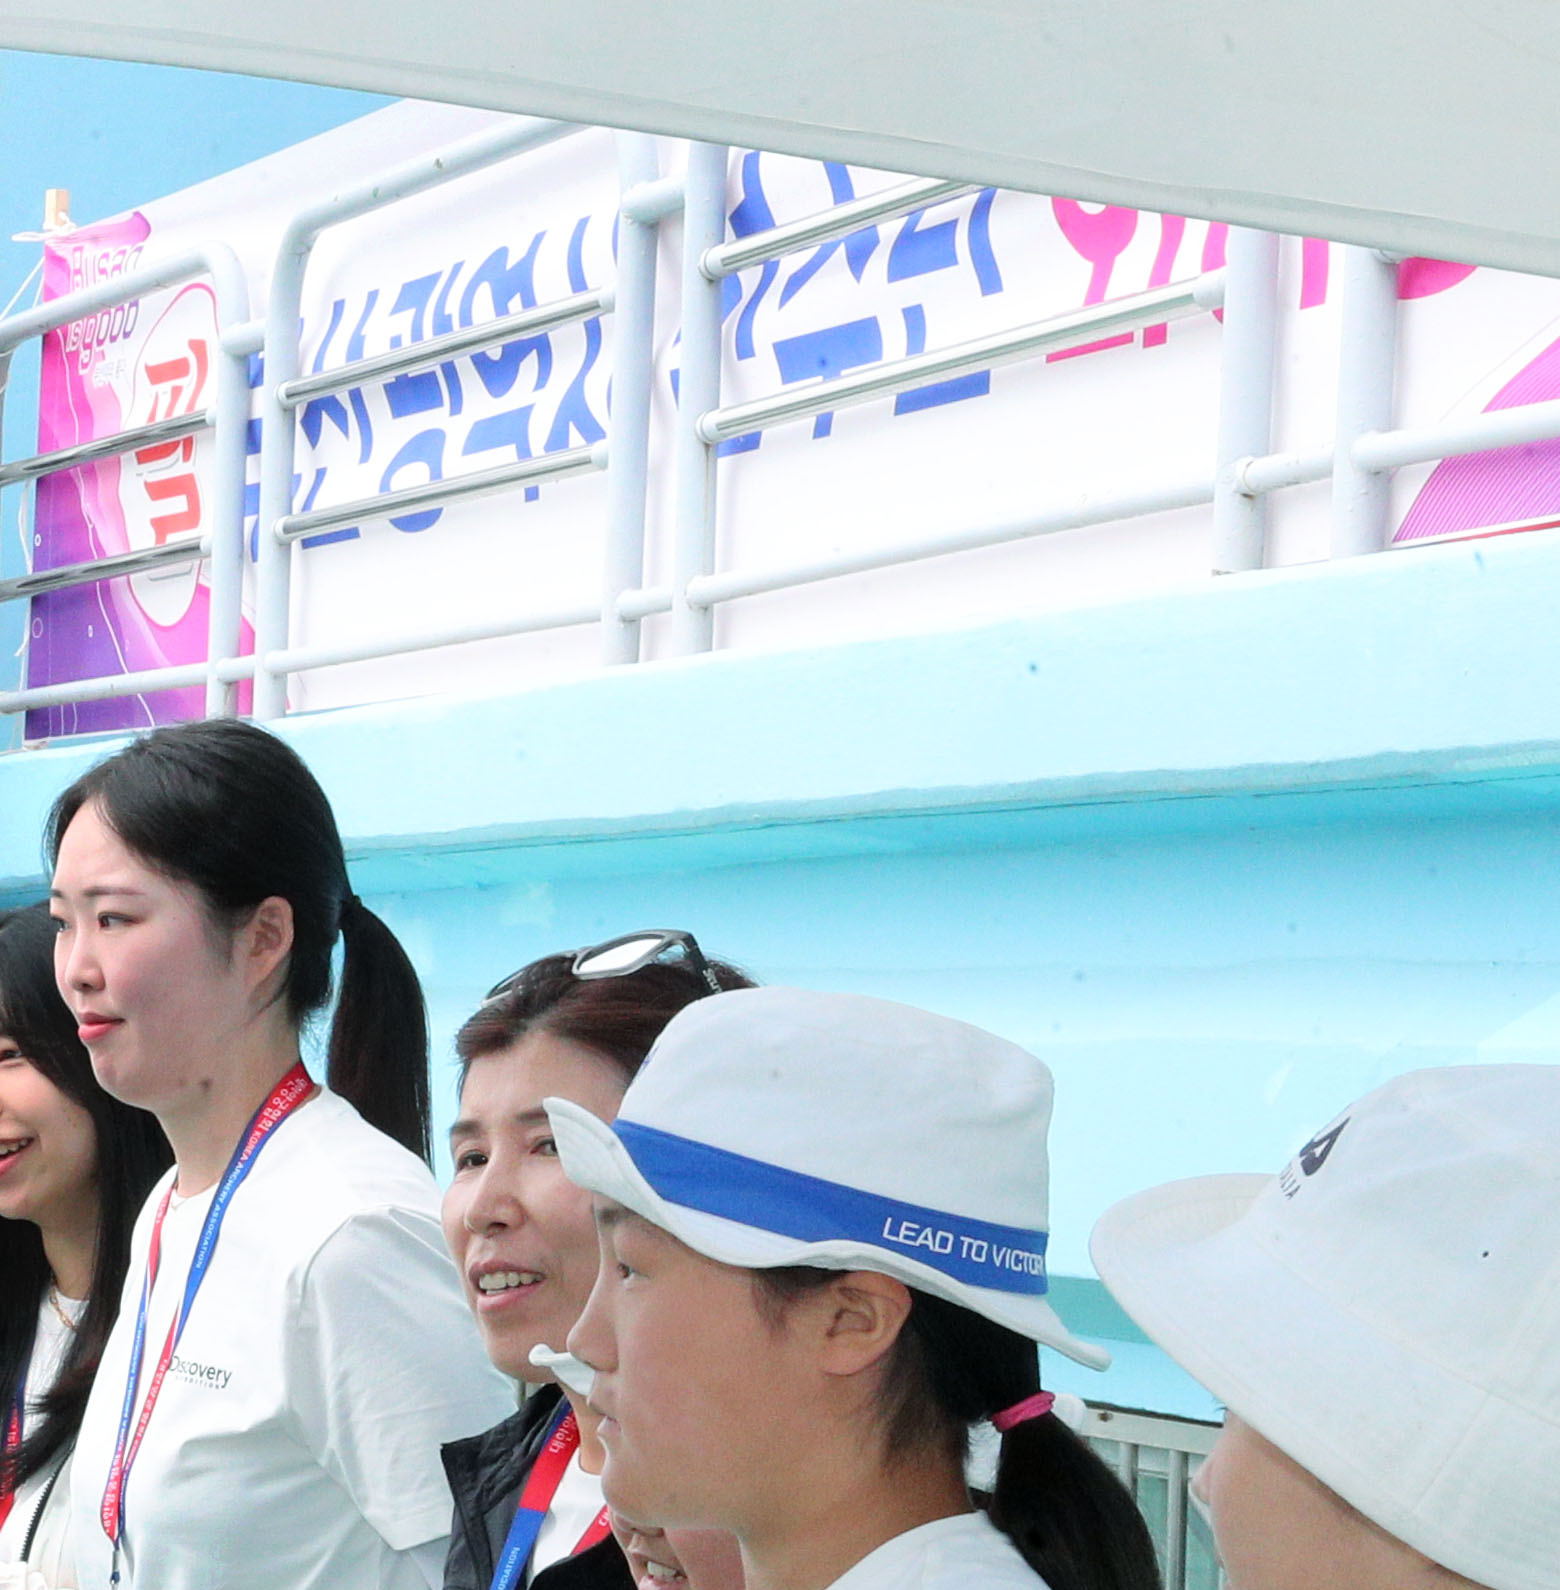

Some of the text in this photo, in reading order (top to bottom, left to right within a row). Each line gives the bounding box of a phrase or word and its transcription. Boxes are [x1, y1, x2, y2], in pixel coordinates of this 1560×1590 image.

[241, 1130, 262, 1162] KOREA
[218, 1161, 245, 1205] ARCHERY
[195, 1203, 222, 1270] ASSOCIATION
[882, 1217, 1044, 1276] LEAD TO VICTOR
